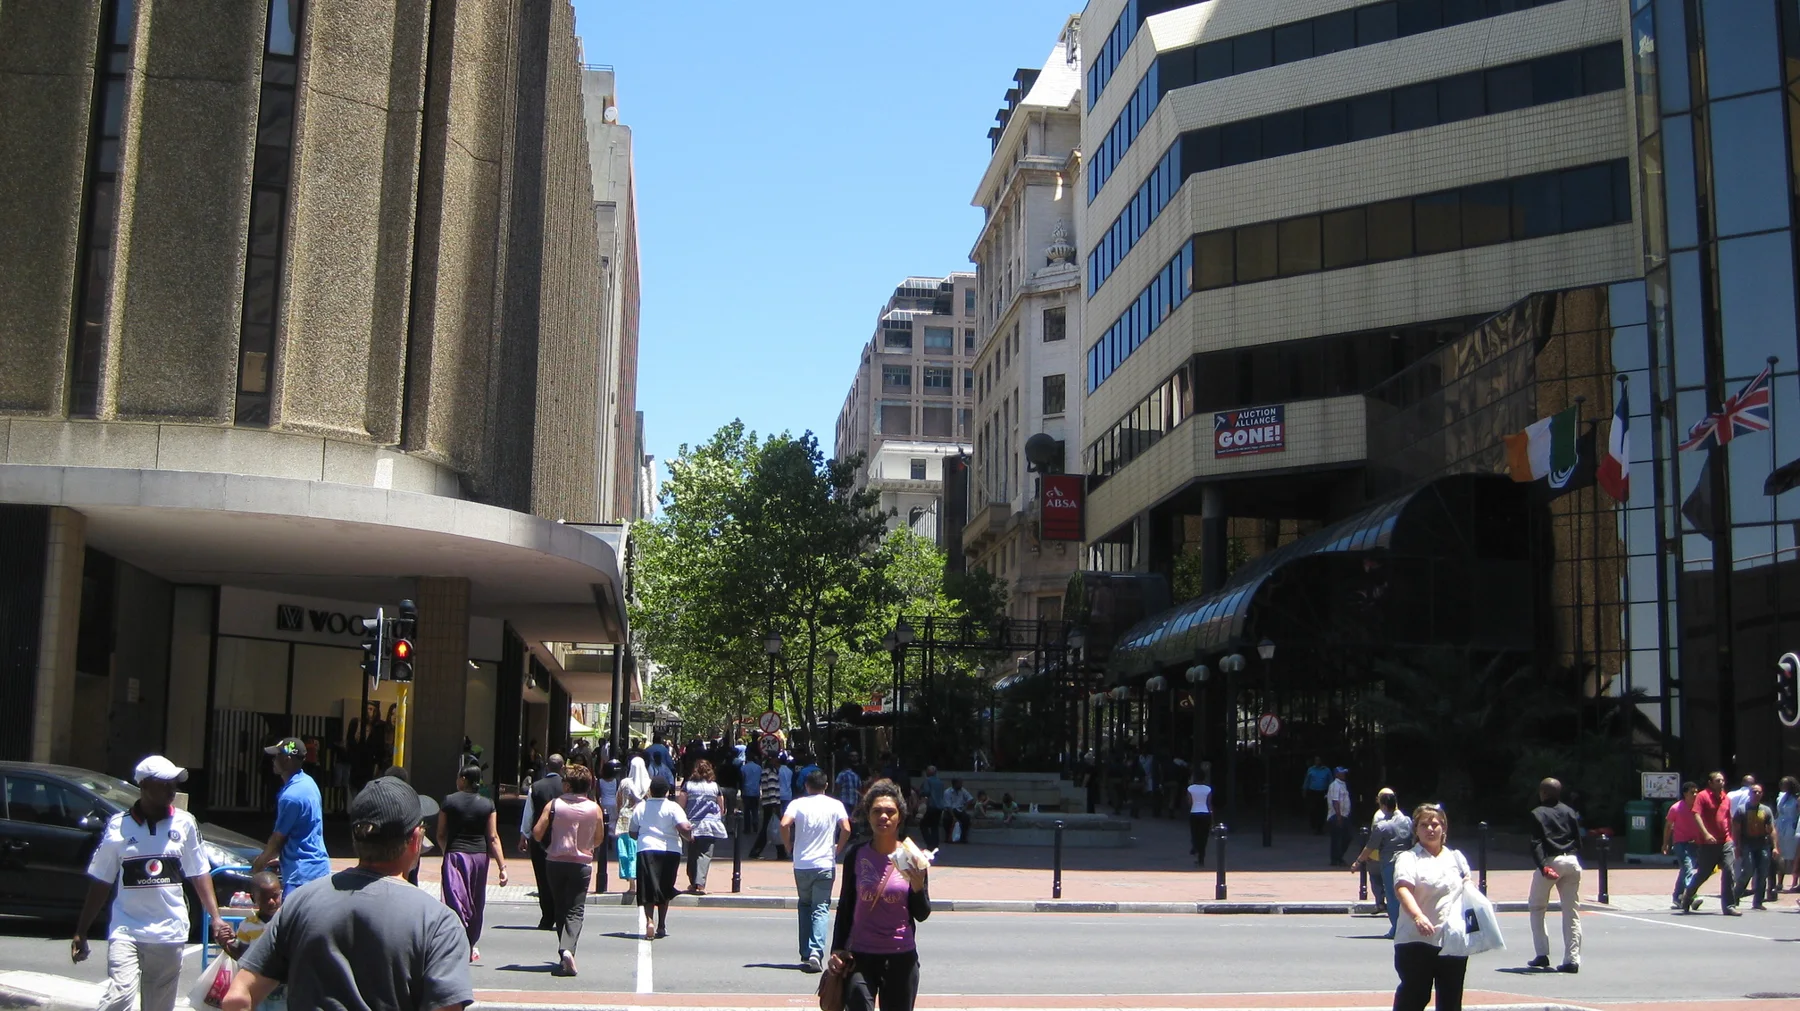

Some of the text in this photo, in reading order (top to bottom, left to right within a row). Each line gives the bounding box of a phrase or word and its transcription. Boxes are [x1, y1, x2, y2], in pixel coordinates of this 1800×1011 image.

[1238, 408, 1276, 419] AUCTION
[1235, 416, 1276, 427] ALLIANCE
[1218, 425, 1280, 447] GONE!
[1046, 499, 1077, 508] ABSA
[137, 877, 171, 885] vodacom
